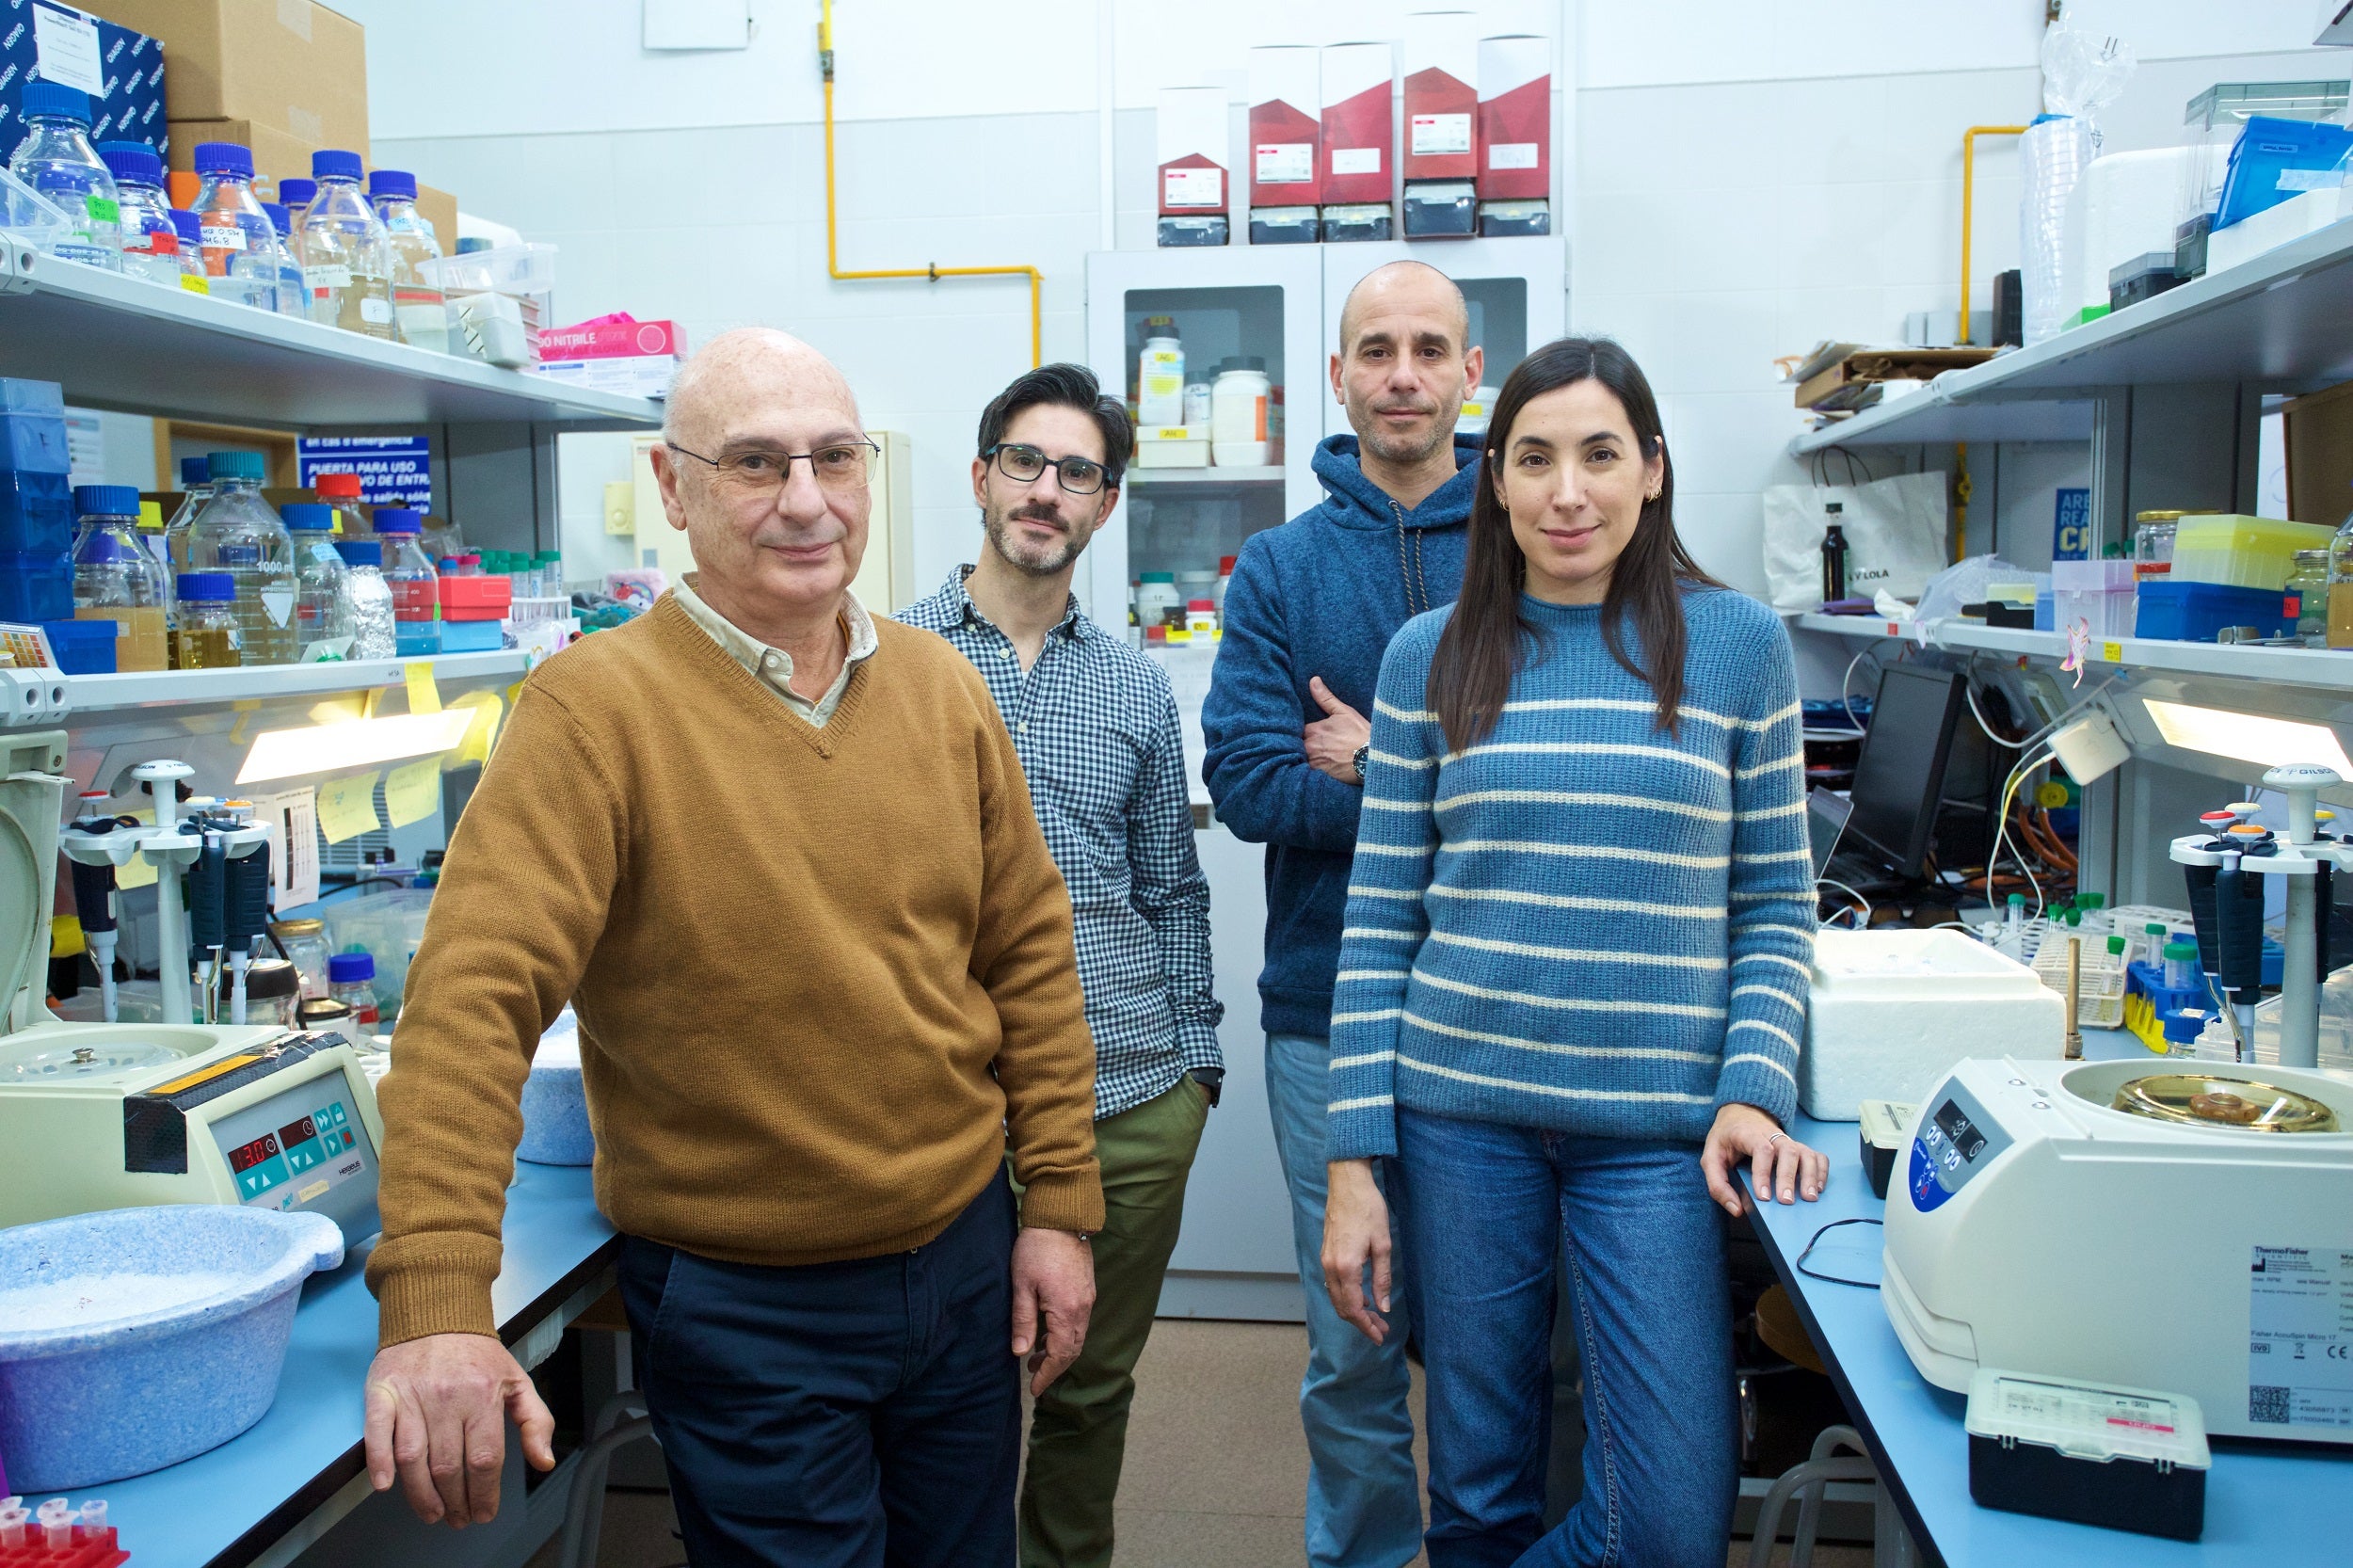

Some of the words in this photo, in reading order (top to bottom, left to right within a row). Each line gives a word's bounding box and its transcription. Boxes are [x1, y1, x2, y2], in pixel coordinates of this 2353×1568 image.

[3, 23, 24, 50] QIAGEN
[106, 38, 126, 63] QIAGEN
[92, 113, 112, 139] QIAGEN
[553, 332, 597, 346] NITRILE
[308, 462, 355, 475] PUERTA
[357, 461, 389, 473] PARA
[390, 460, 417, 473] USO
[376, 473, 394, 487] DE
[256, 561, 282, 572] 1000
[1864, 568, 1889, 581] LOLA
